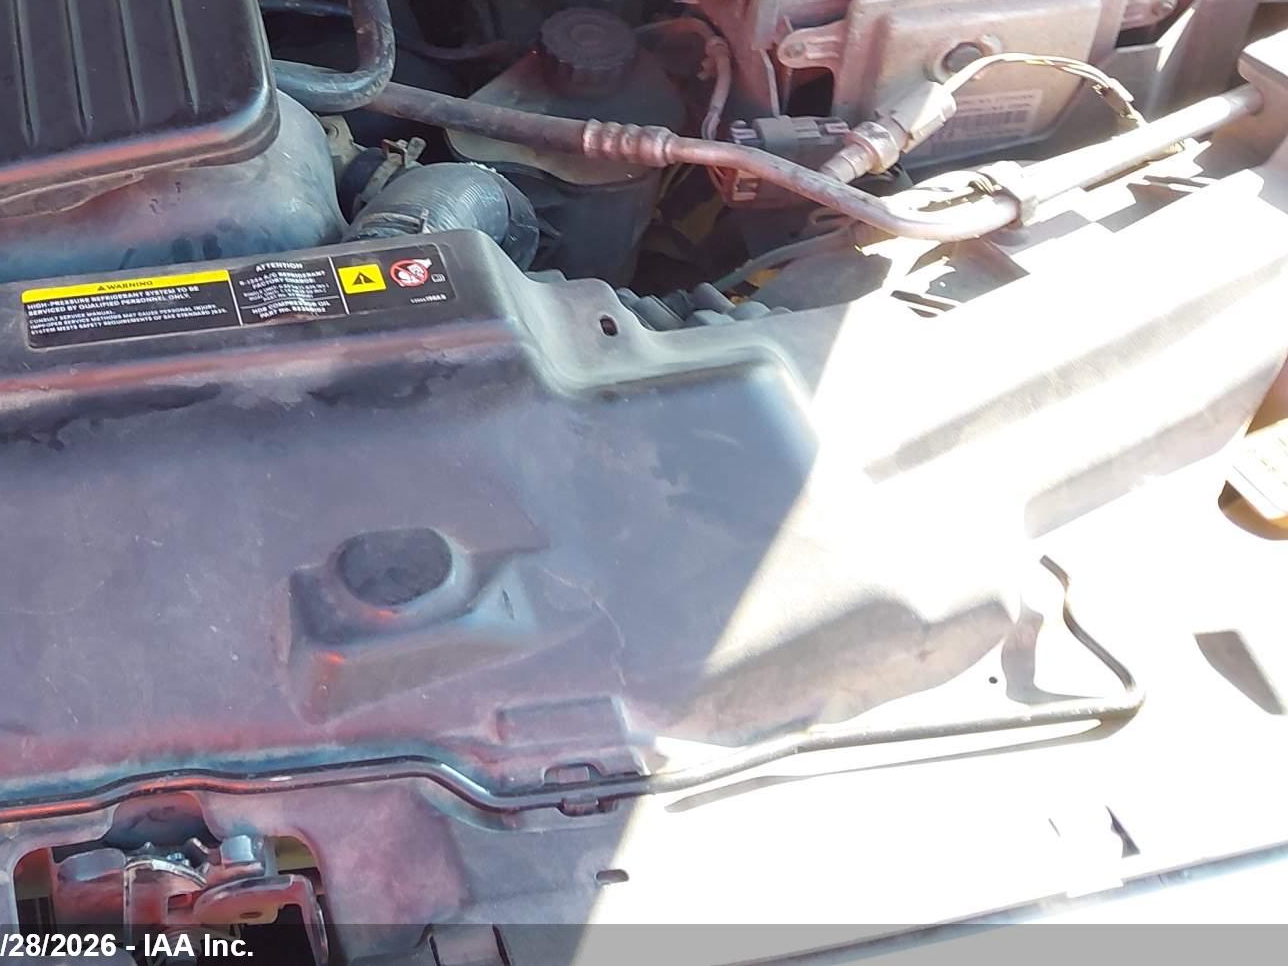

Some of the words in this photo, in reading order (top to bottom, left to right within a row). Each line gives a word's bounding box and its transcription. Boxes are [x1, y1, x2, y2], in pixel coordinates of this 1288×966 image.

[255, 262, 302, 272] ATTENTION
[277, 269, 325, 280] REFRIGERANT
[106, 279, 153, 290] WARNING
[251, 277, 285, 289] FACTORY
[26, 296, 89, 309] HIGH-PRESSURE
[90, 291, 144, 302] REFRIGERANT
[144, 287, 175, 296] SYSTEM
[27, 306, 66, 316] SERVICED
[78, 300, 120, 309] QUALIFIED
[120, 295, 167, 305] PERSONNEL
